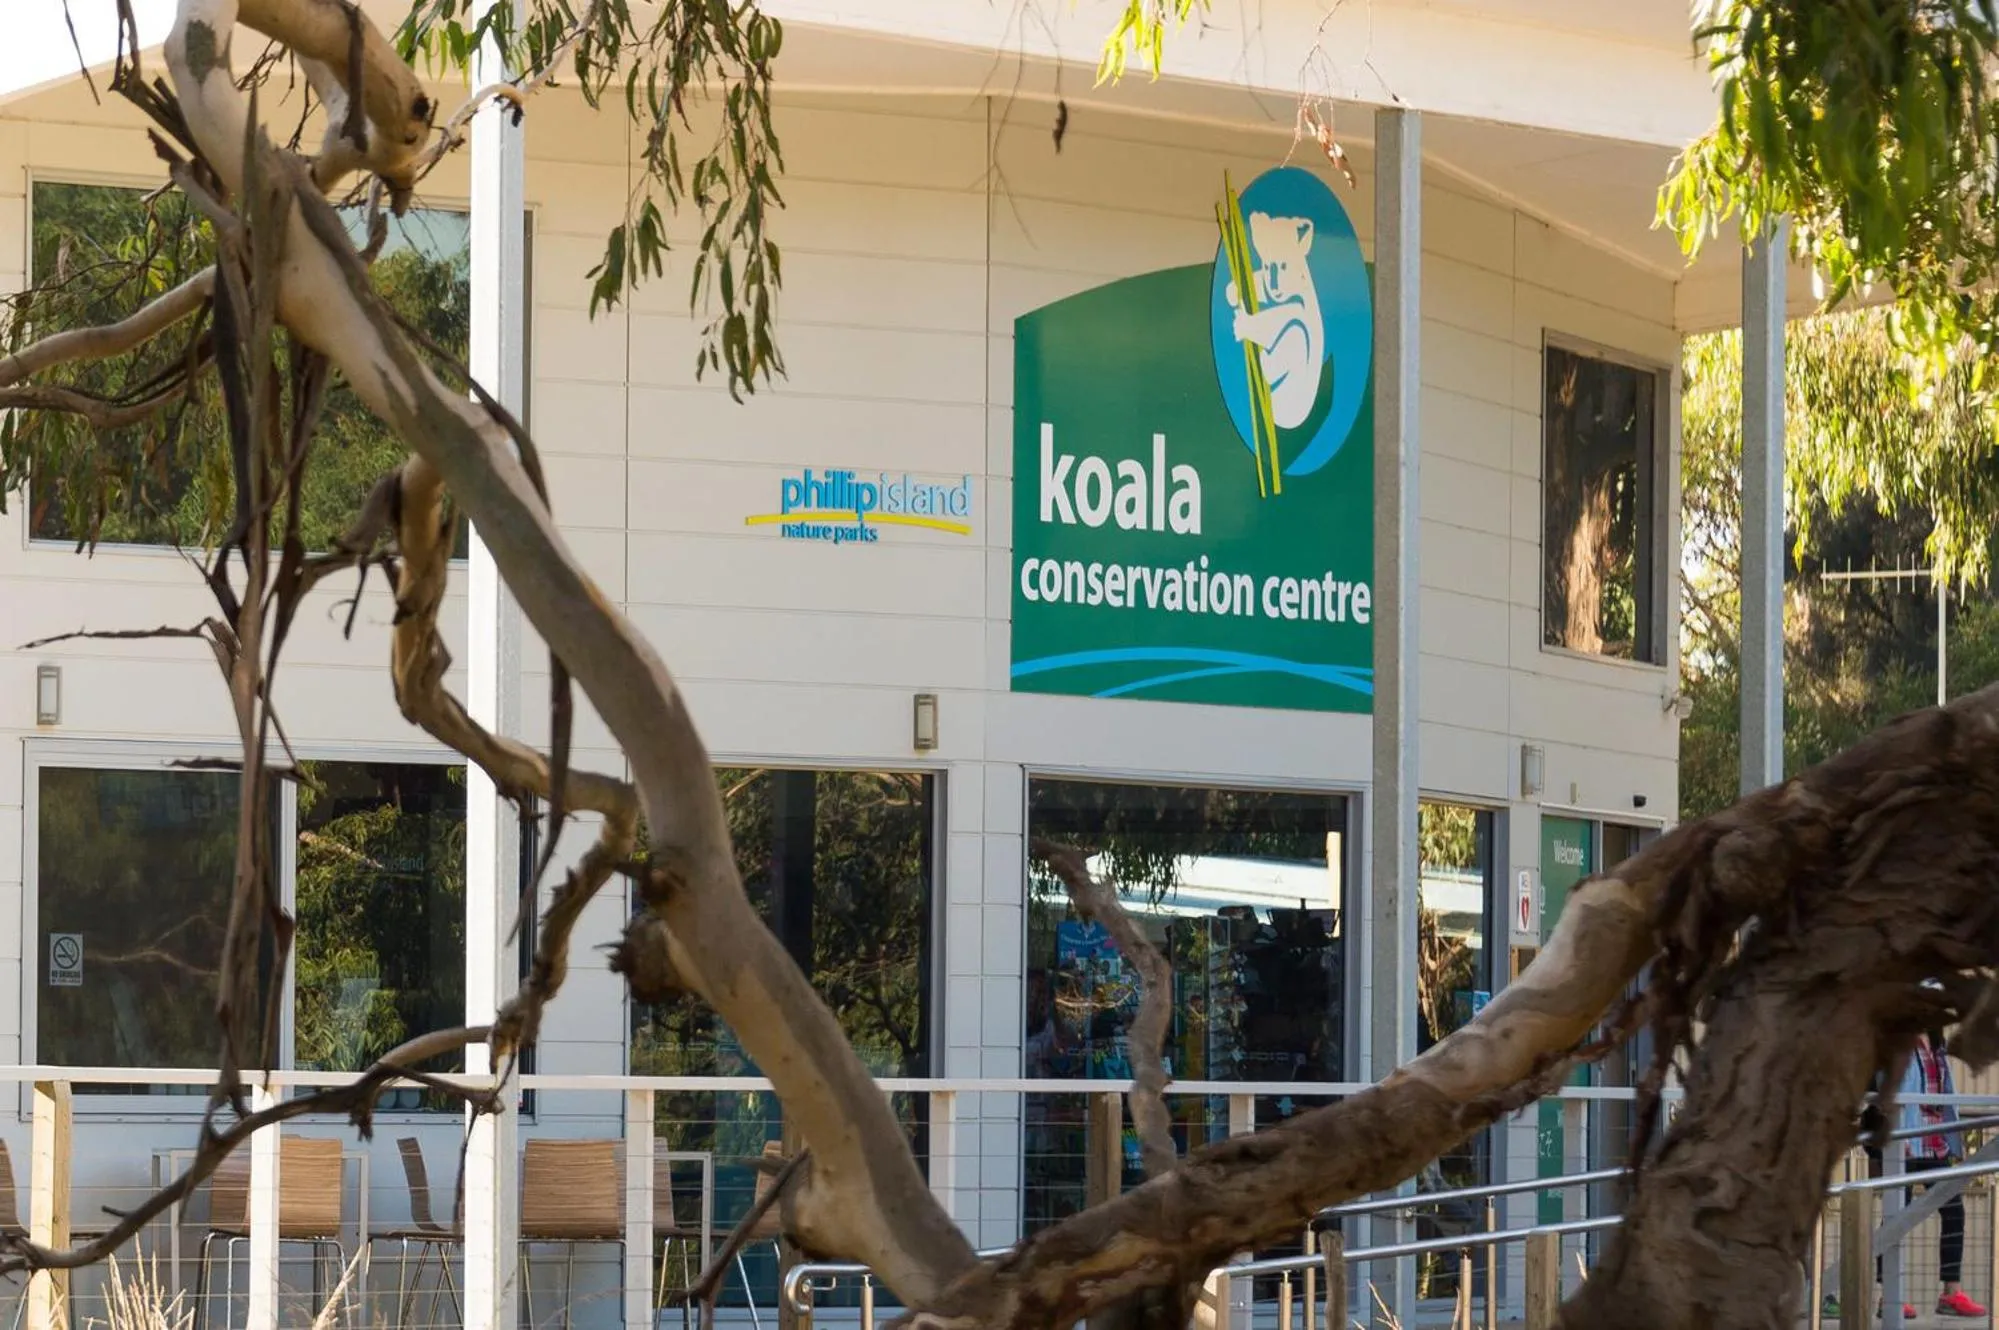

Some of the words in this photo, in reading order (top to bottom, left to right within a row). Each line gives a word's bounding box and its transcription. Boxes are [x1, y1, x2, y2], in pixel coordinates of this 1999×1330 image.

[1040, 422, 1202, 535] koala
[781, 521, 832, 540] nature
[833, 522, 878, 545] parks
[1020, 555, 1254, 616] conservation
[1262, 570, 1371, 625] centre
